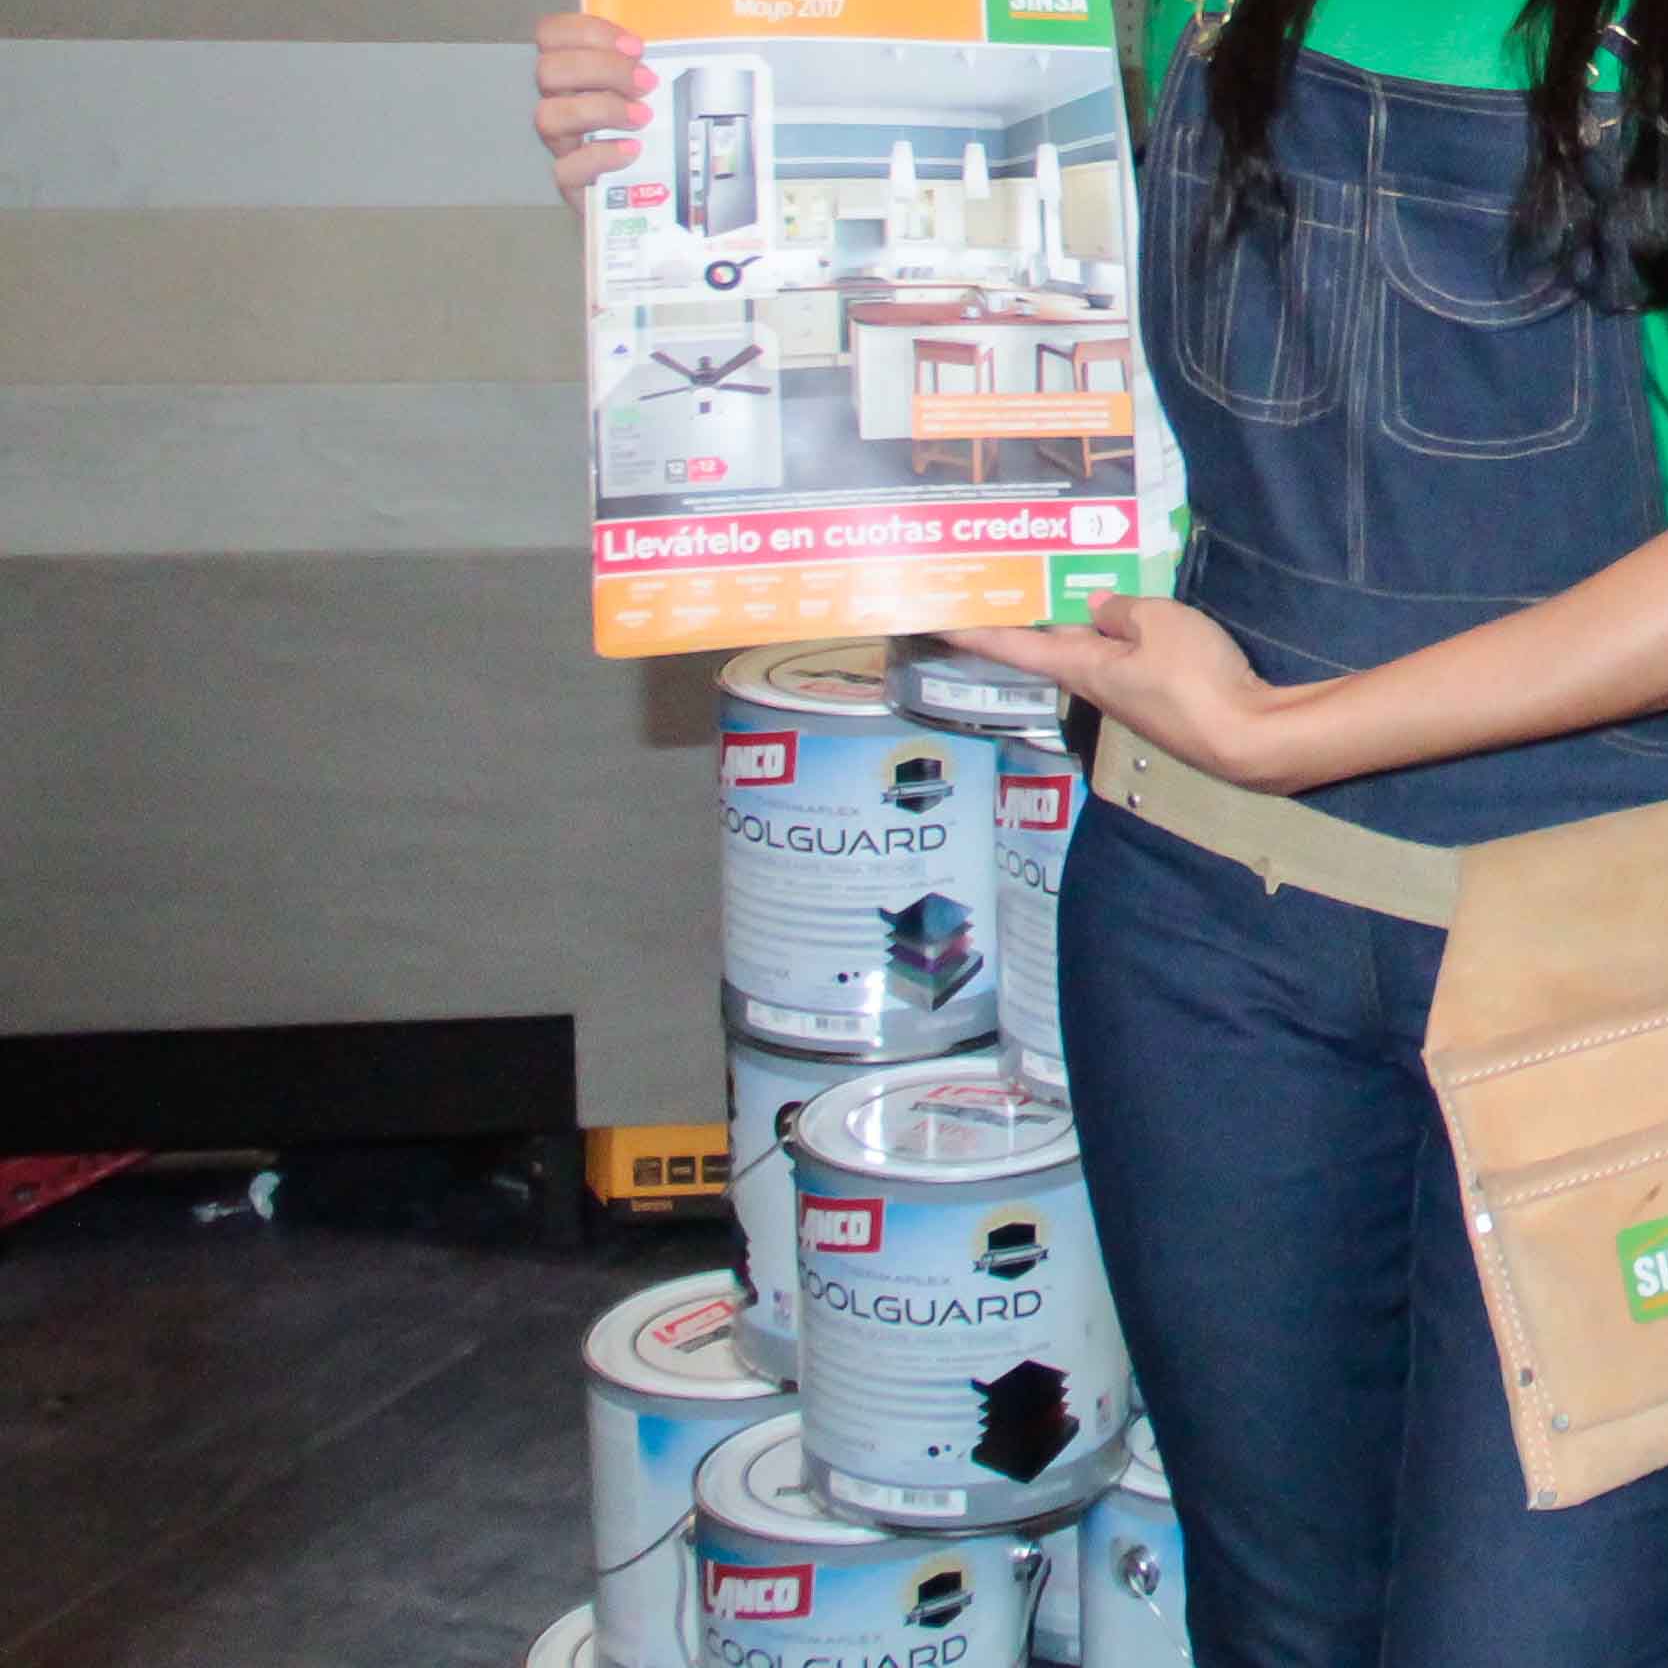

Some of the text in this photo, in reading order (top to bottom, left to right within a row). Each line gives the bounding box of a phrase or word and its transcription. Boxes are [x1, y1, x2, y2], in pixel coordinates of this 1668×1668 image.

[603, 507, 1068, 562] Llevátelo en cuotas credex
[721, 743, 787, 787] ANCO
[800, 1209, 873, 1253] ANCO
